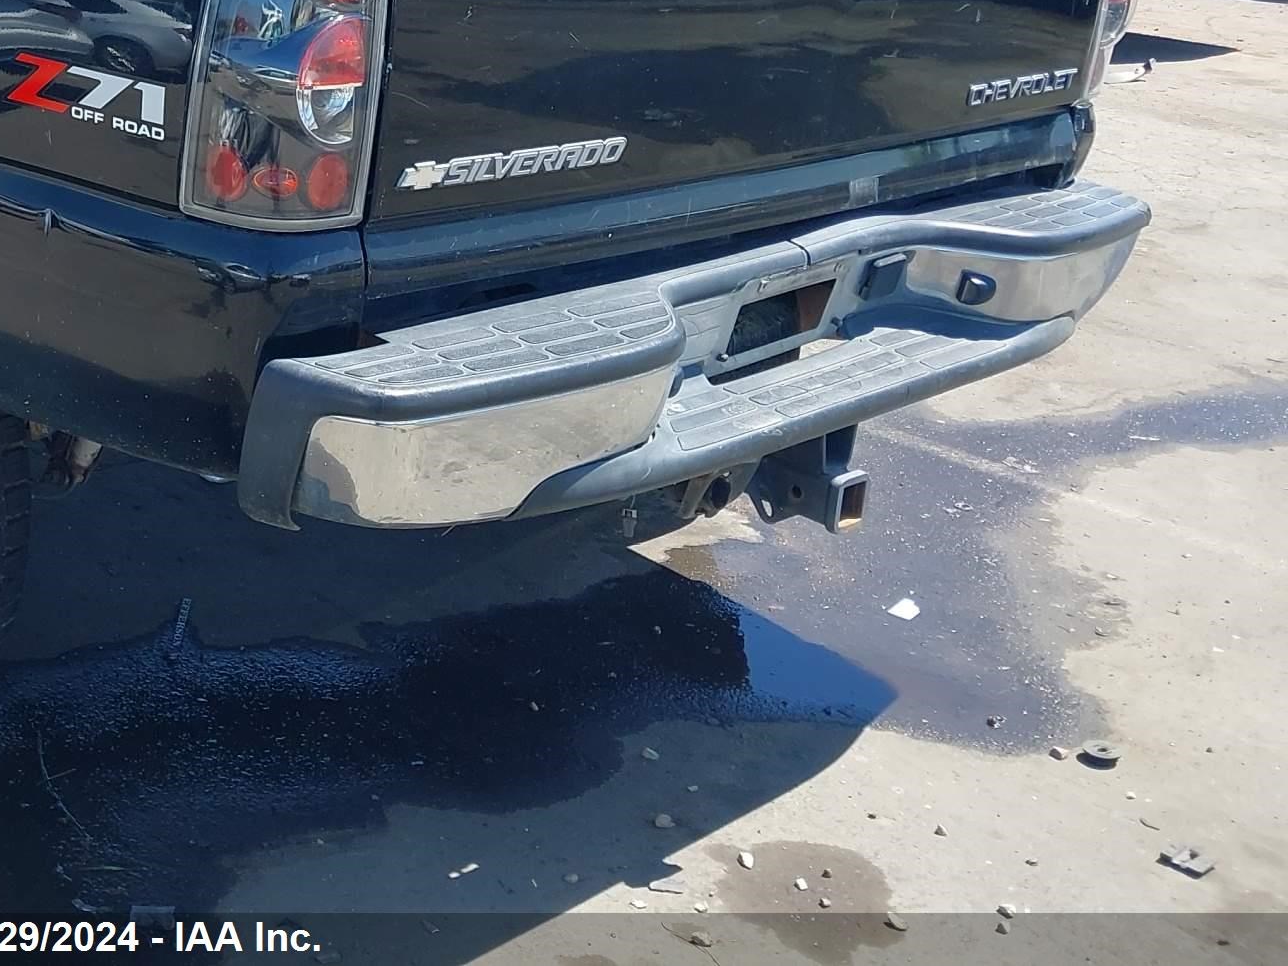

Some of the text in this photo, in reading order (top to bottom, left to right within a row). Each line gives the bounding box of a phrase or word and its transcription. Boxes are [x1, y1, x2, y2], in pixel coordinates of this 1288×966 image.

[7, 52, 166, 126] Z71
[968, 68, 1078, 106] CHEVROLET
[71, 105, 165, 141] OFF ROAD
[443, 136, 628, 185] SILVERADO
